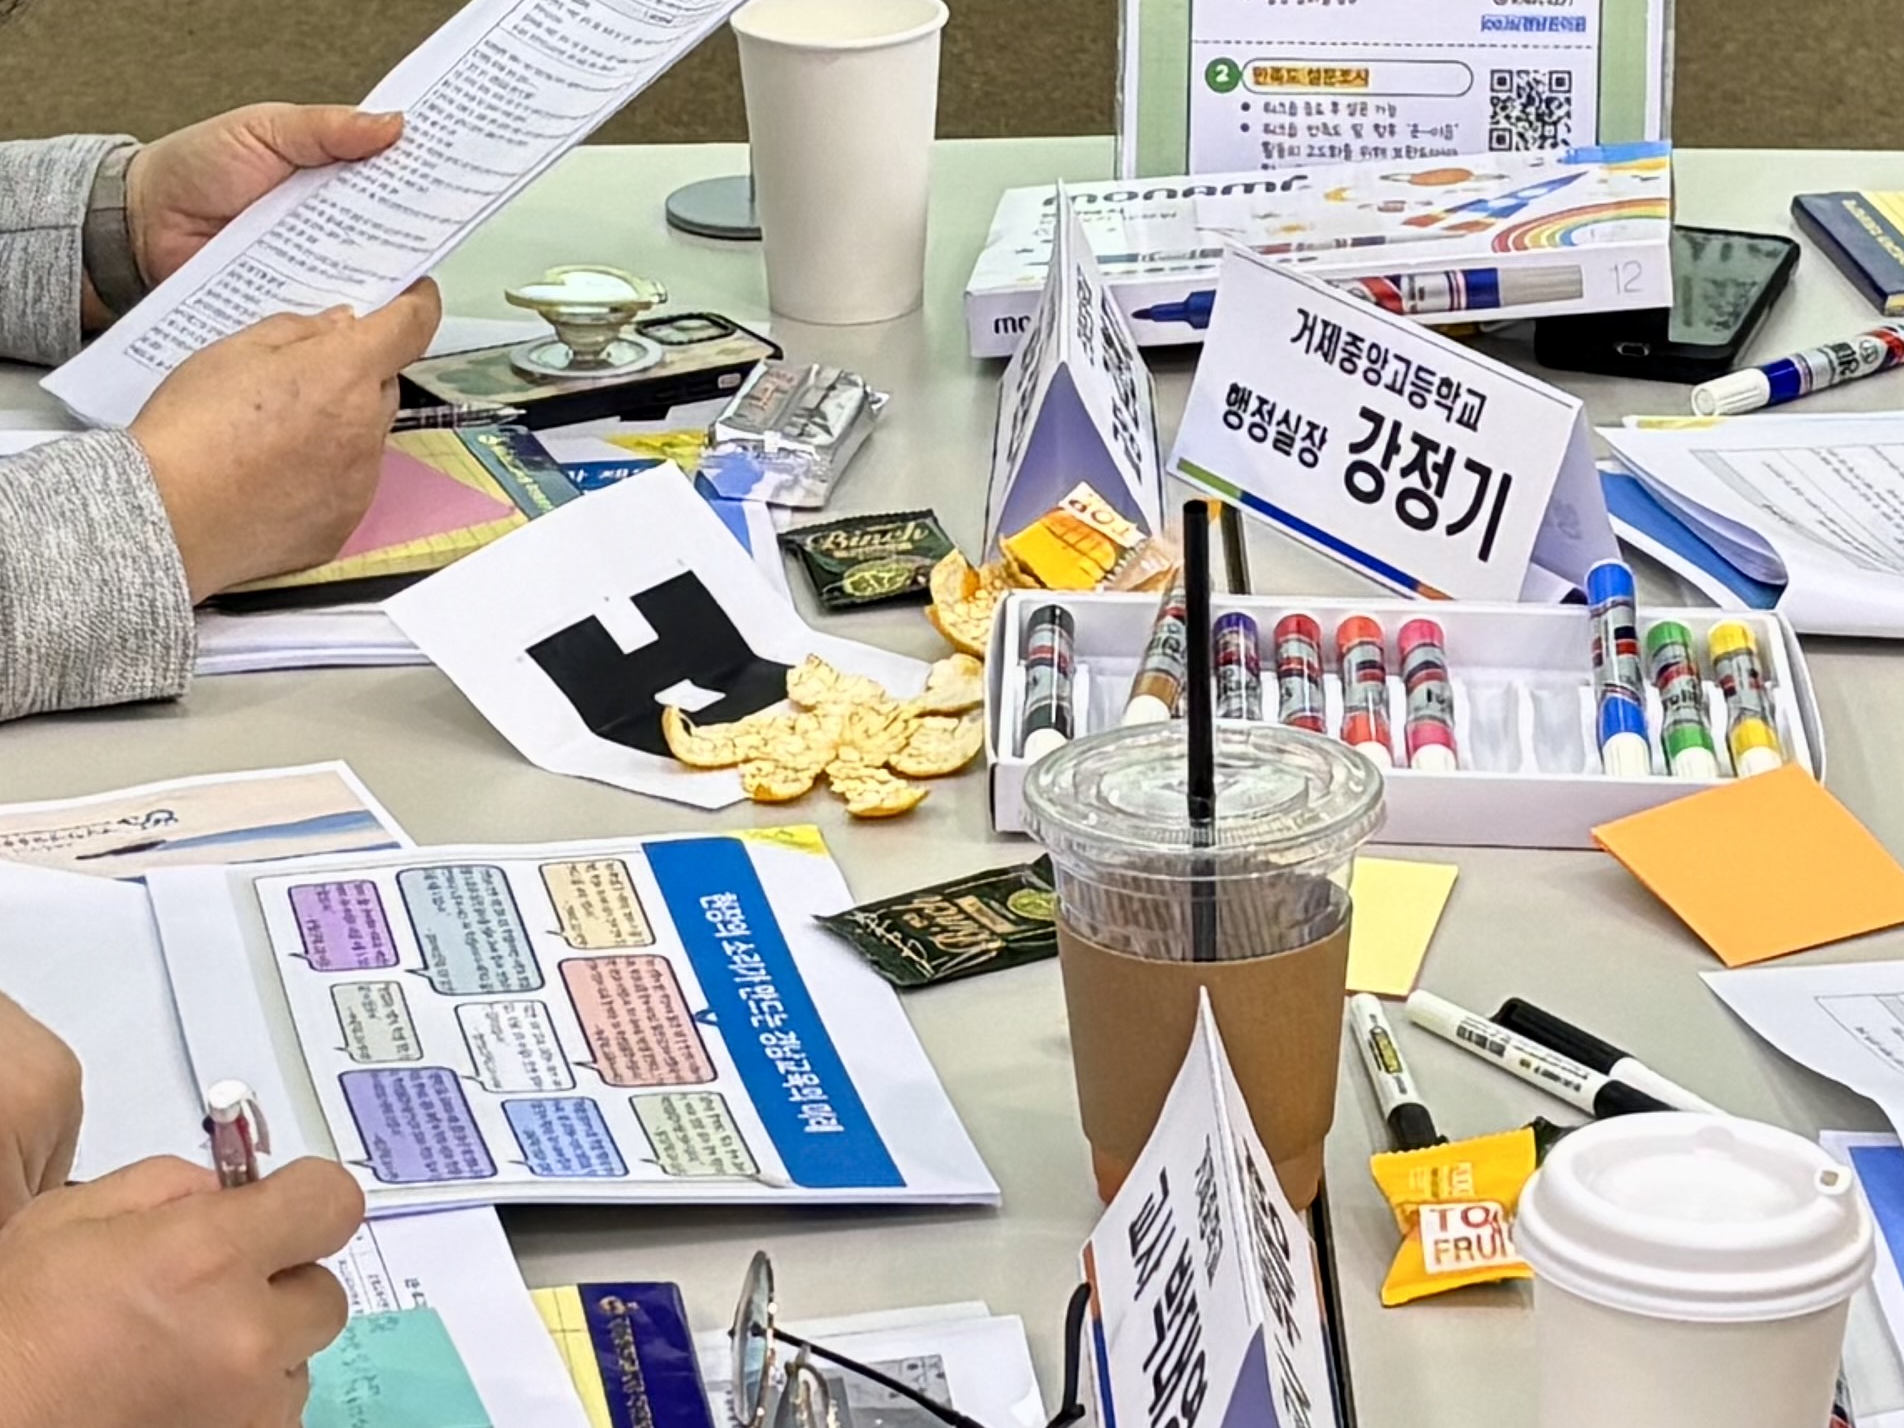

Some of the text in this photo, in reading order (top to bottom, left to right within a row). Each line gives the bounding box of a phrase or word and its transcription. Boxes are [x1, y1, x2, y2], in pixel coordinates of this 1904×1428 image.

[1214, 64, 1229, 83] 2
[1610, 260, 1645, 295] 12
[1291, 307, 1488, 433] 거제중앙고등학교
[1222, 381, 1328, 469] 행정실장
[1343, 404, 1514, 564] 강정기
